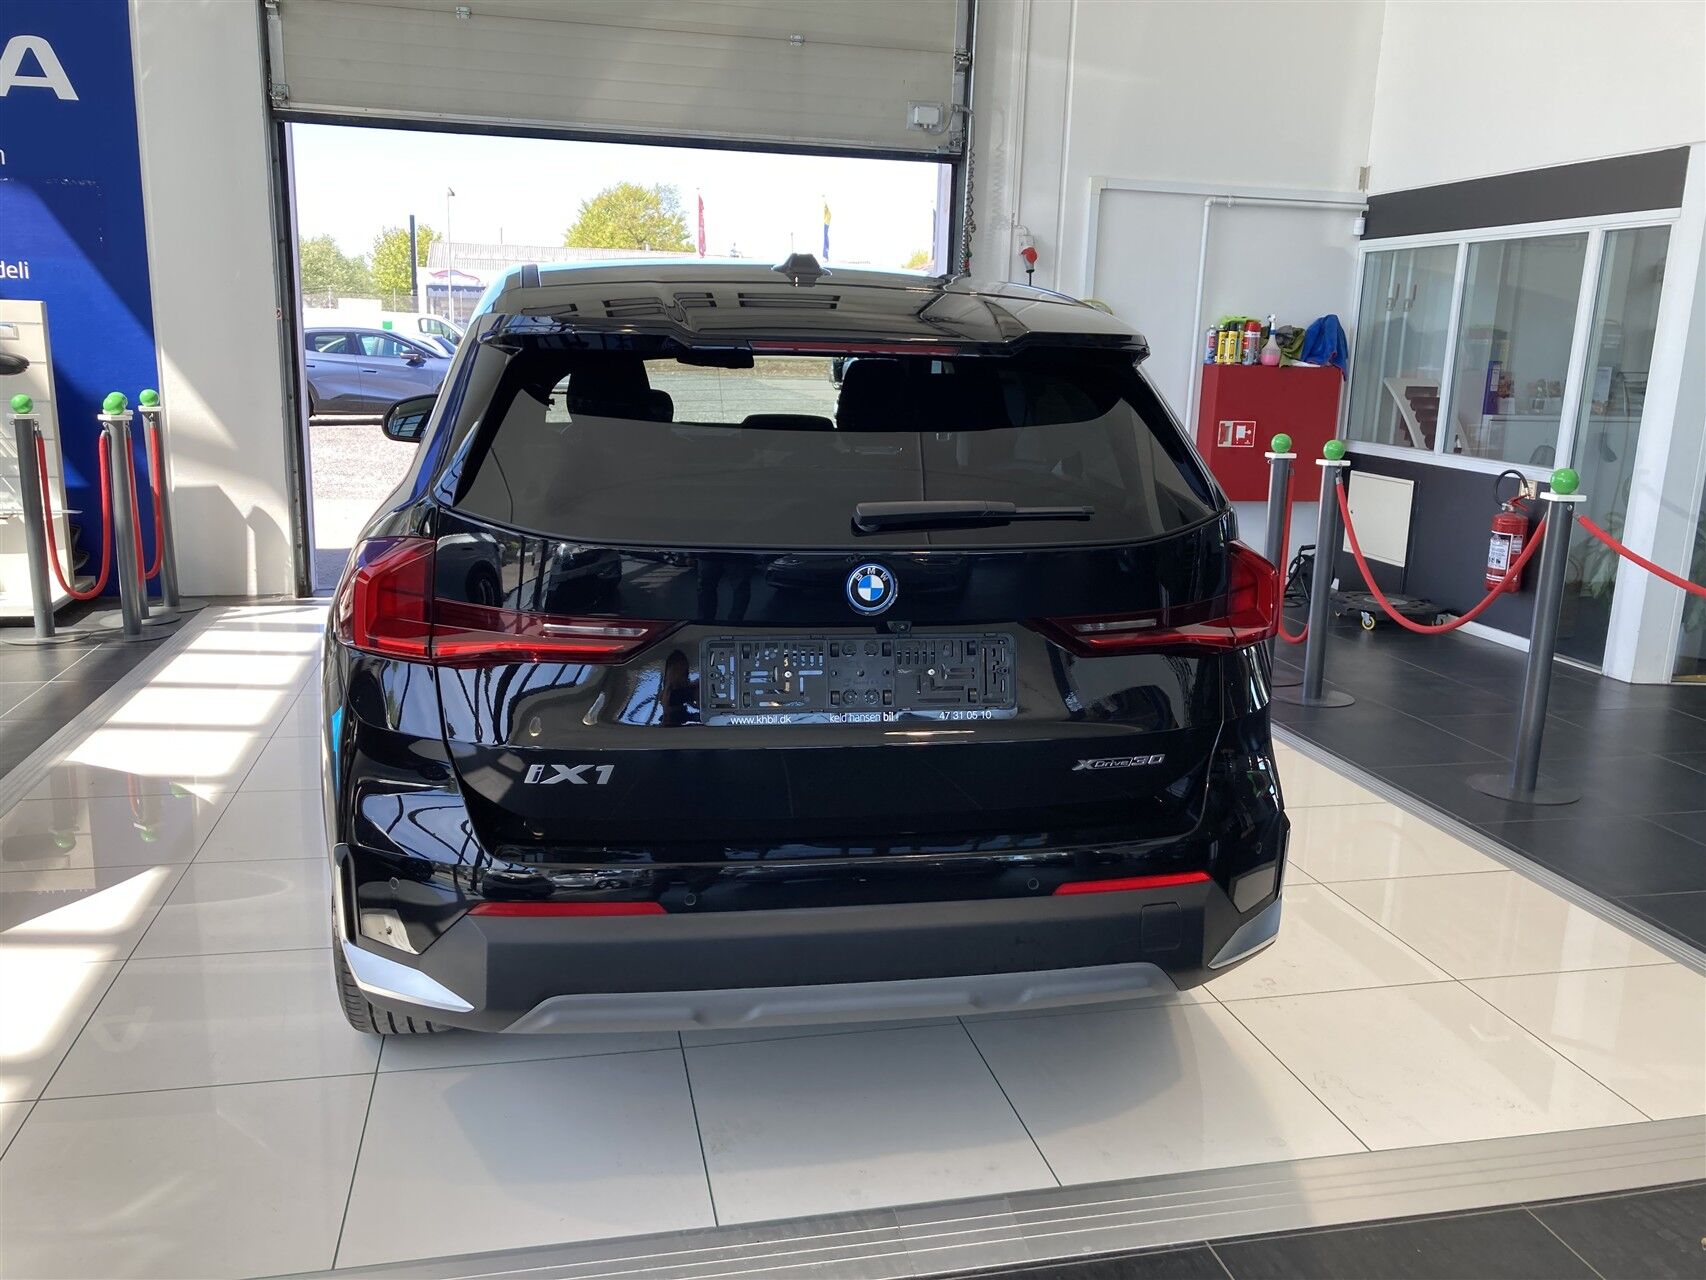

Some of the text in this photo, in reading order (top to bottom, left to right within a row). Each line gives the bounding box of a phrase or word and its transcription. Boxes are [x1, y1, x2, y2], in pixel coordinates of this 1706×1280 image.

[854, 567, 889, 582] BMW
[730, 715, 792, 725] www.khbil.dk
[829, 713, 847, 723] keld
[848, 713, 881, 722] hansen
[939, 710, 992, 720] 47 31 05 10
[523, 764, 615, 785] iX1
